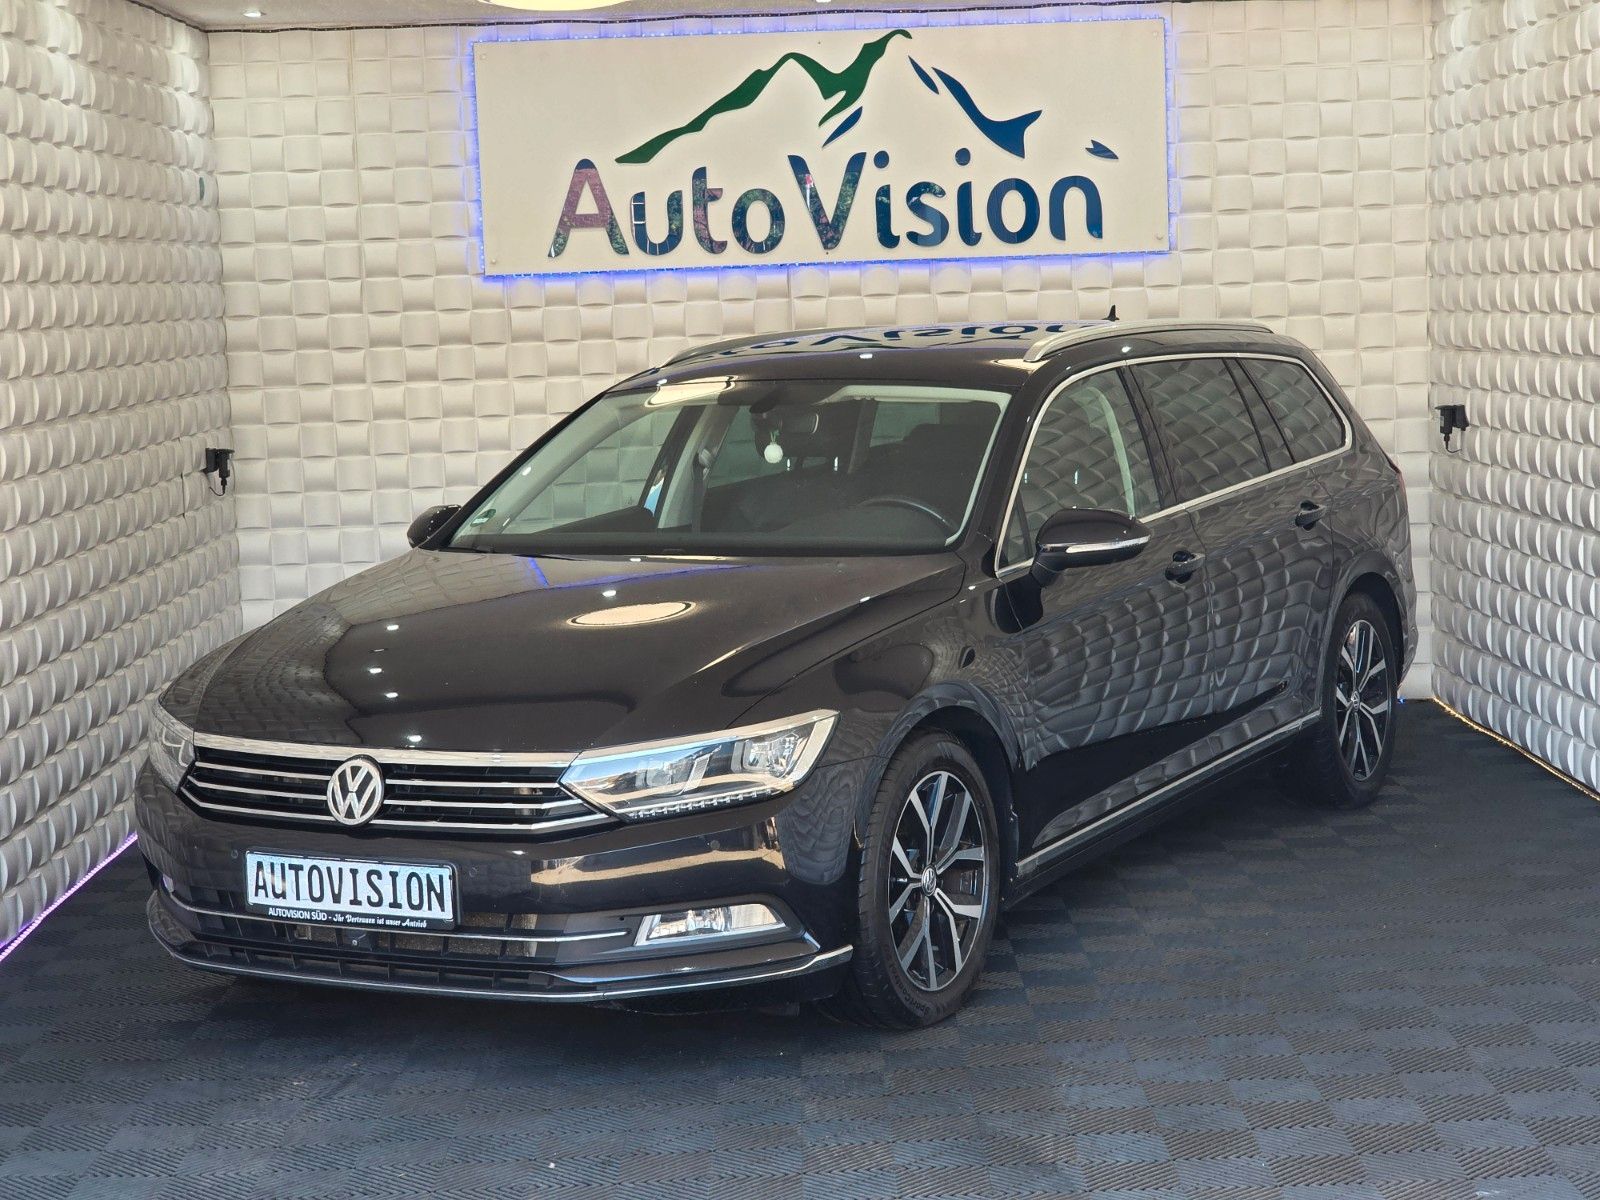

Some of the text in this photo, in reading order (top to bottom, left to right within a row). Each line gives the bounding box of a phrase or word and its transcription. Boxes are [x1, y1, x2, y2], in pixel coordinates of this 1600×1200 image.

[548, 149, 1104, 259] AutoVision
[330, 761, 380, 823] VW
[254, 861, 446, 913] AUTOVISION
[268, 907, 310, 920] AUTOVISION
[311, 909, 328, 921] SÜD
[376, 917, 385, 925] ist
[401, 918, 427, 928] Antrieb
